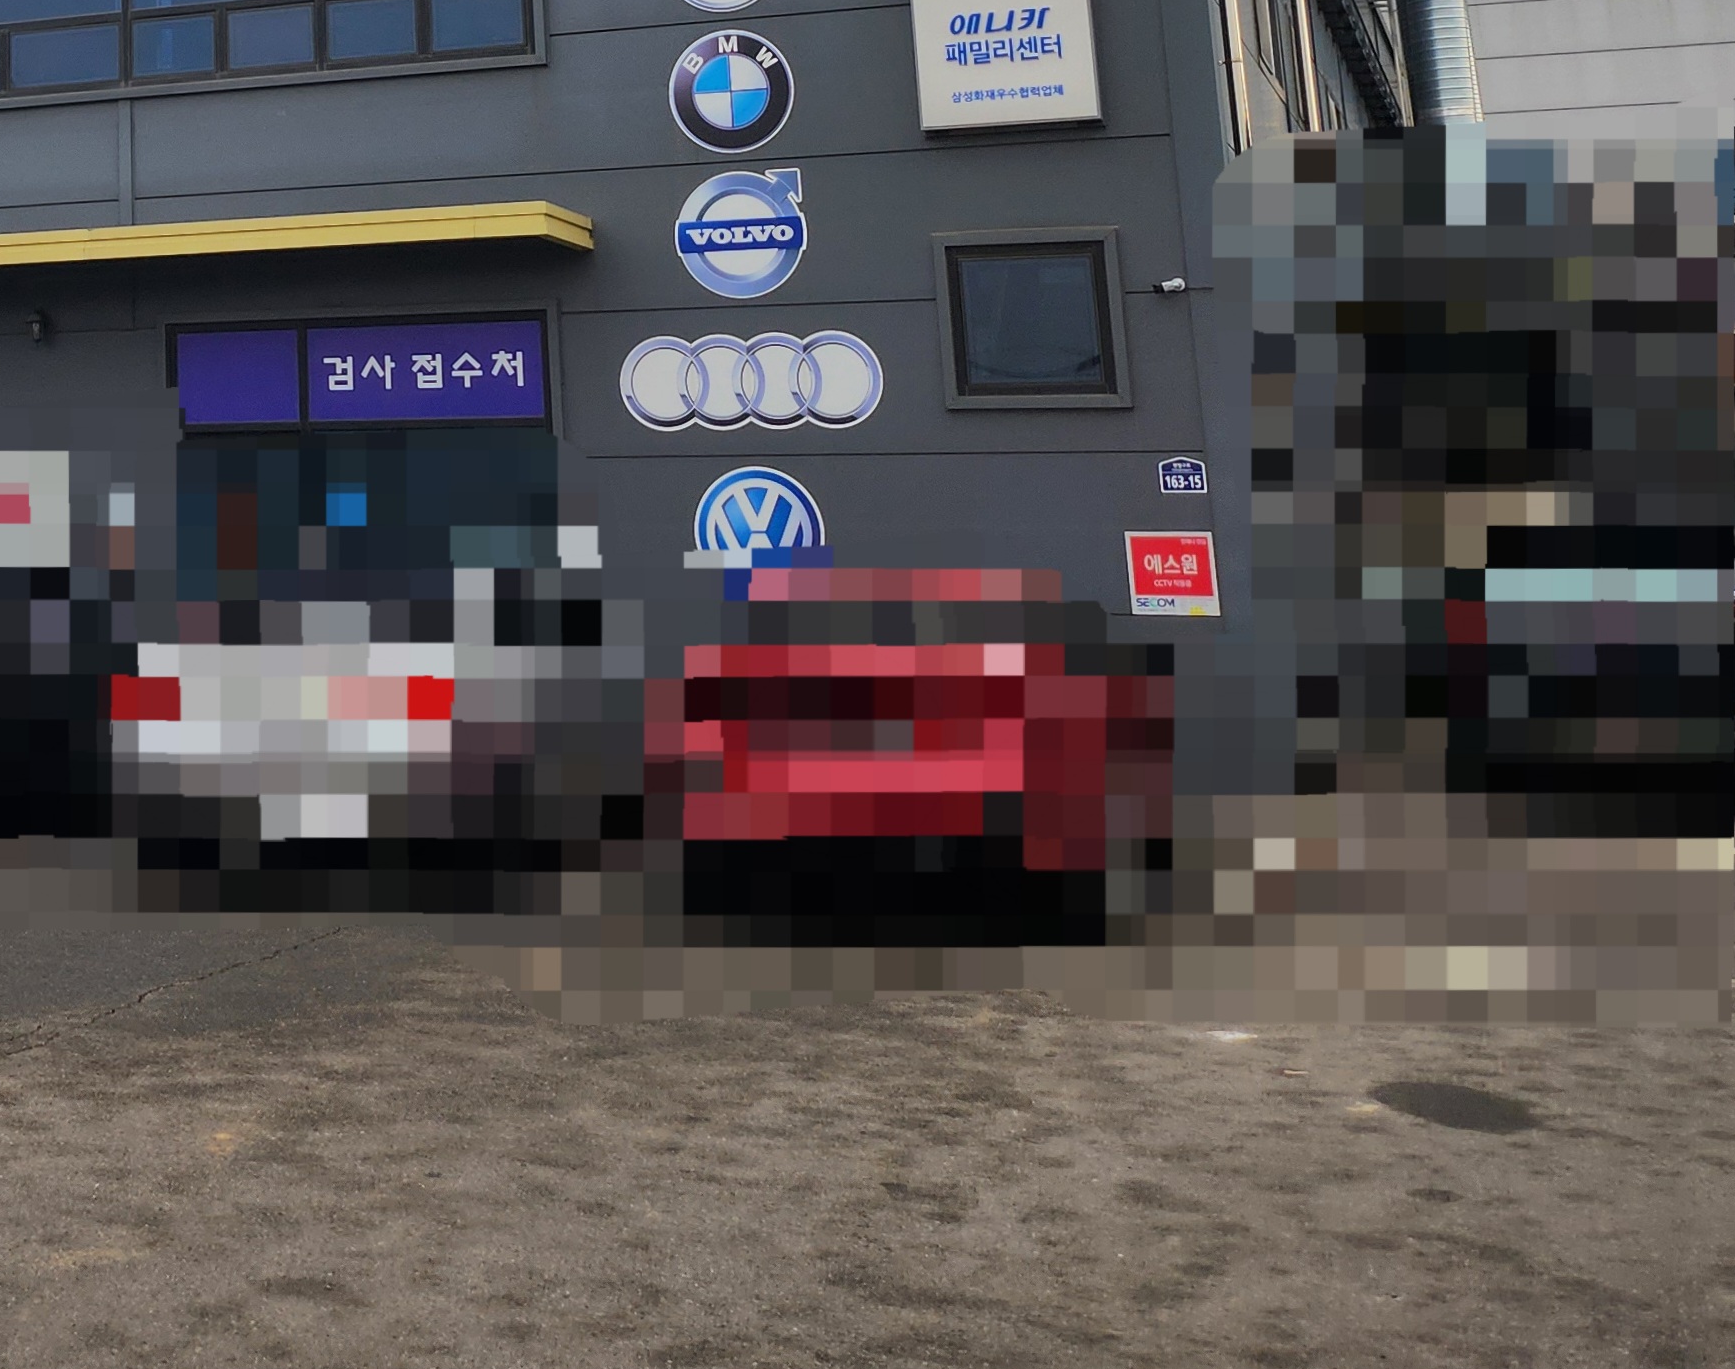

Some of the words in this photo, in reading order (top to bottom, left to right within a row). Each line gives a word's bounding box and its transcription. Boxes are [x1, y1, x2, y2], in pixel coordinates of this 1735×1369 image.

[682, 35, 779, 75] BMW
[945, 34, 1063, 66] 패밀리센터
[951, 84, 1064, 104] 삼성화재우수협력업체
[685, 225, 795, 246] VOLVO
[322, 354, 396, 391] 검사
[411, 350, 526, 389] 접수처
[1165, 474, 1202, 489] 163-15
[1143, 554, 1198, 575] 에스원
[1153, 579, 1173, 587] CCTV
[1136, 597, 1175, 608] SECOM
